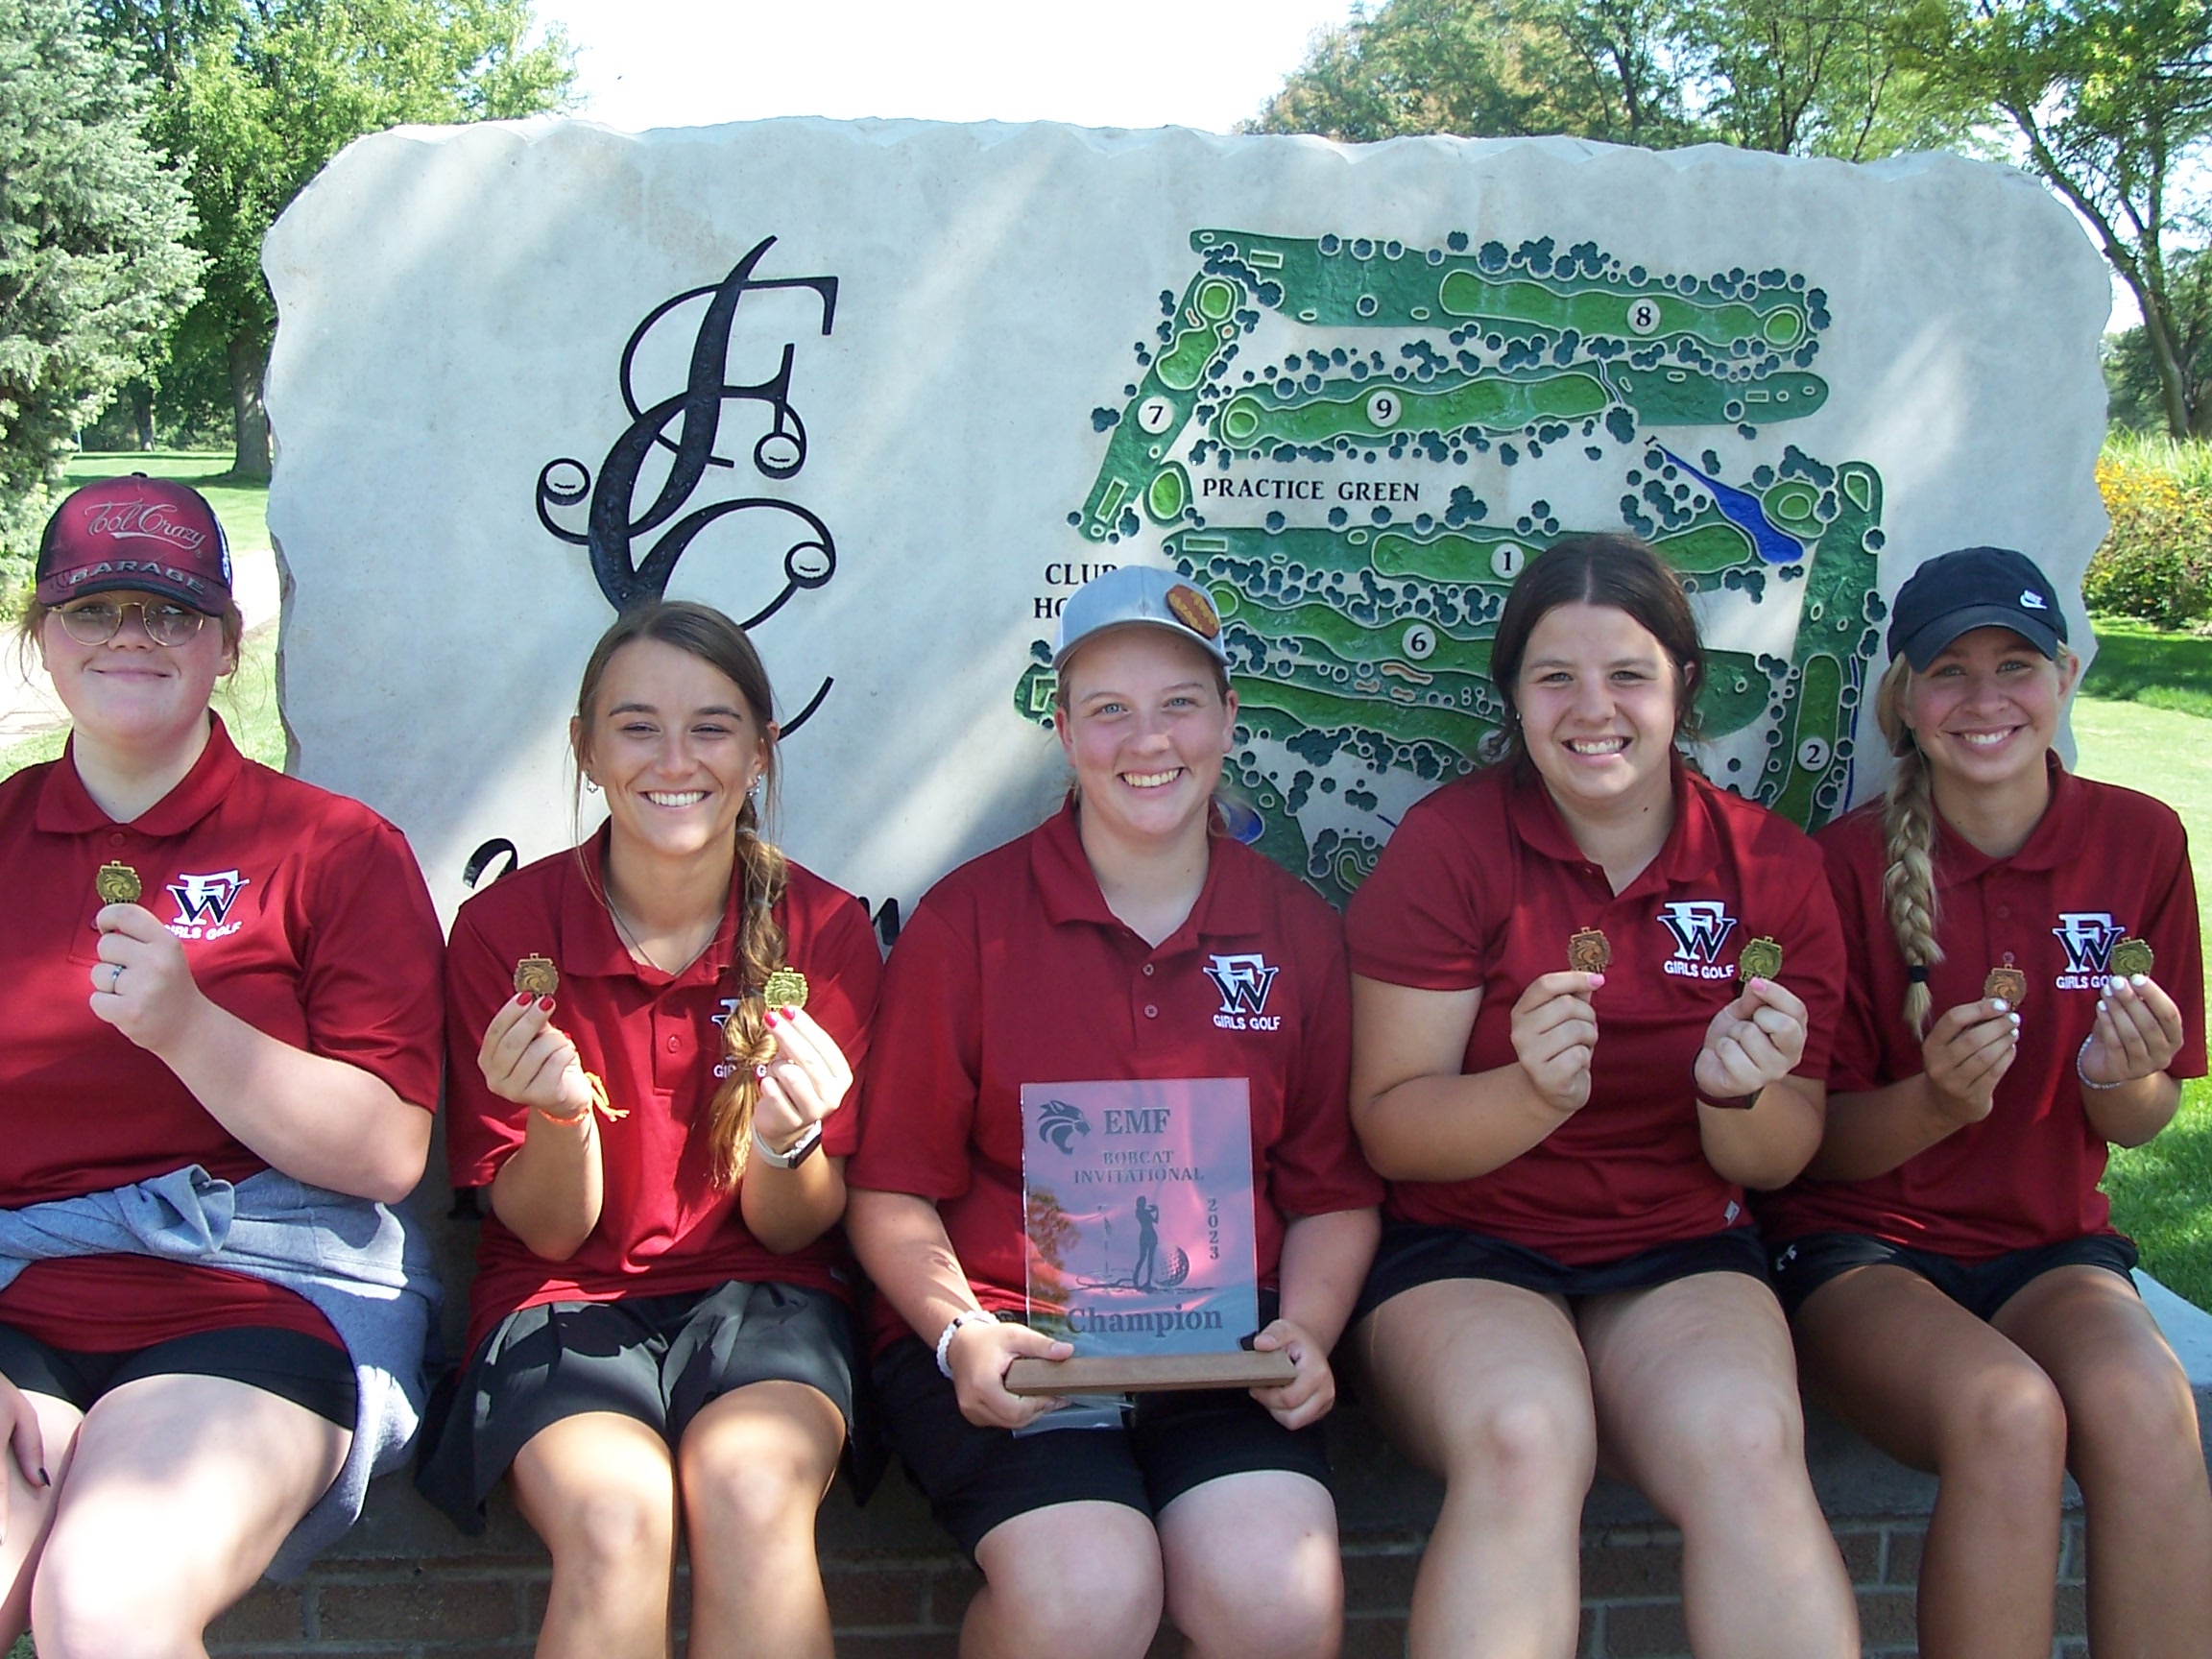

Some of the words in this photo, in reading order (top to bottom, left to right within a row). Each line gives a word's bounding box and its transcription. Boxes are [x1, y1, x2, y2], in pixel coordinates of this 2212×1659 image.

[1636, 306, 1651, 326] 8
[1148, 405, 1164, 424] 7
[1376, 398, 1392, 420] 9
[1203, 478, 1325, 500] PRACTICE
[1338, 481, 1420, 501] GREEN
[84, 498, 143, 536] Tool
[138, 503, 206, 550] Crazy
[1503, 551, 1511, 571] 1
[69, 561, 205, 594] GARAGE
[1411, 632, 1427, 652] 6
[1806, 744, 1820, 763] 2
[205, 922, 242, 940] GOLF
[1664, 960, 1699, 977] GIRLS
[1701, 964, 1734, 979] GOLF
[2056, 974, 2088, 989] GIRLS
[2090, 974, 2112, 988] GO
[1213, 1014, 1246, 1030] GIRLS
[1249, 1016, 1281, 1030] GOLF
[1103, 1108, 1171, 1134] EMF
[1103, 1150, 1174, 1166] BOBCAT
[1073, 1166, 1205, 1184] INVITATIONAL
[1207, 1197, 1220, 1260] 2023
[1066, 1304, 1223, 1337] Champion
